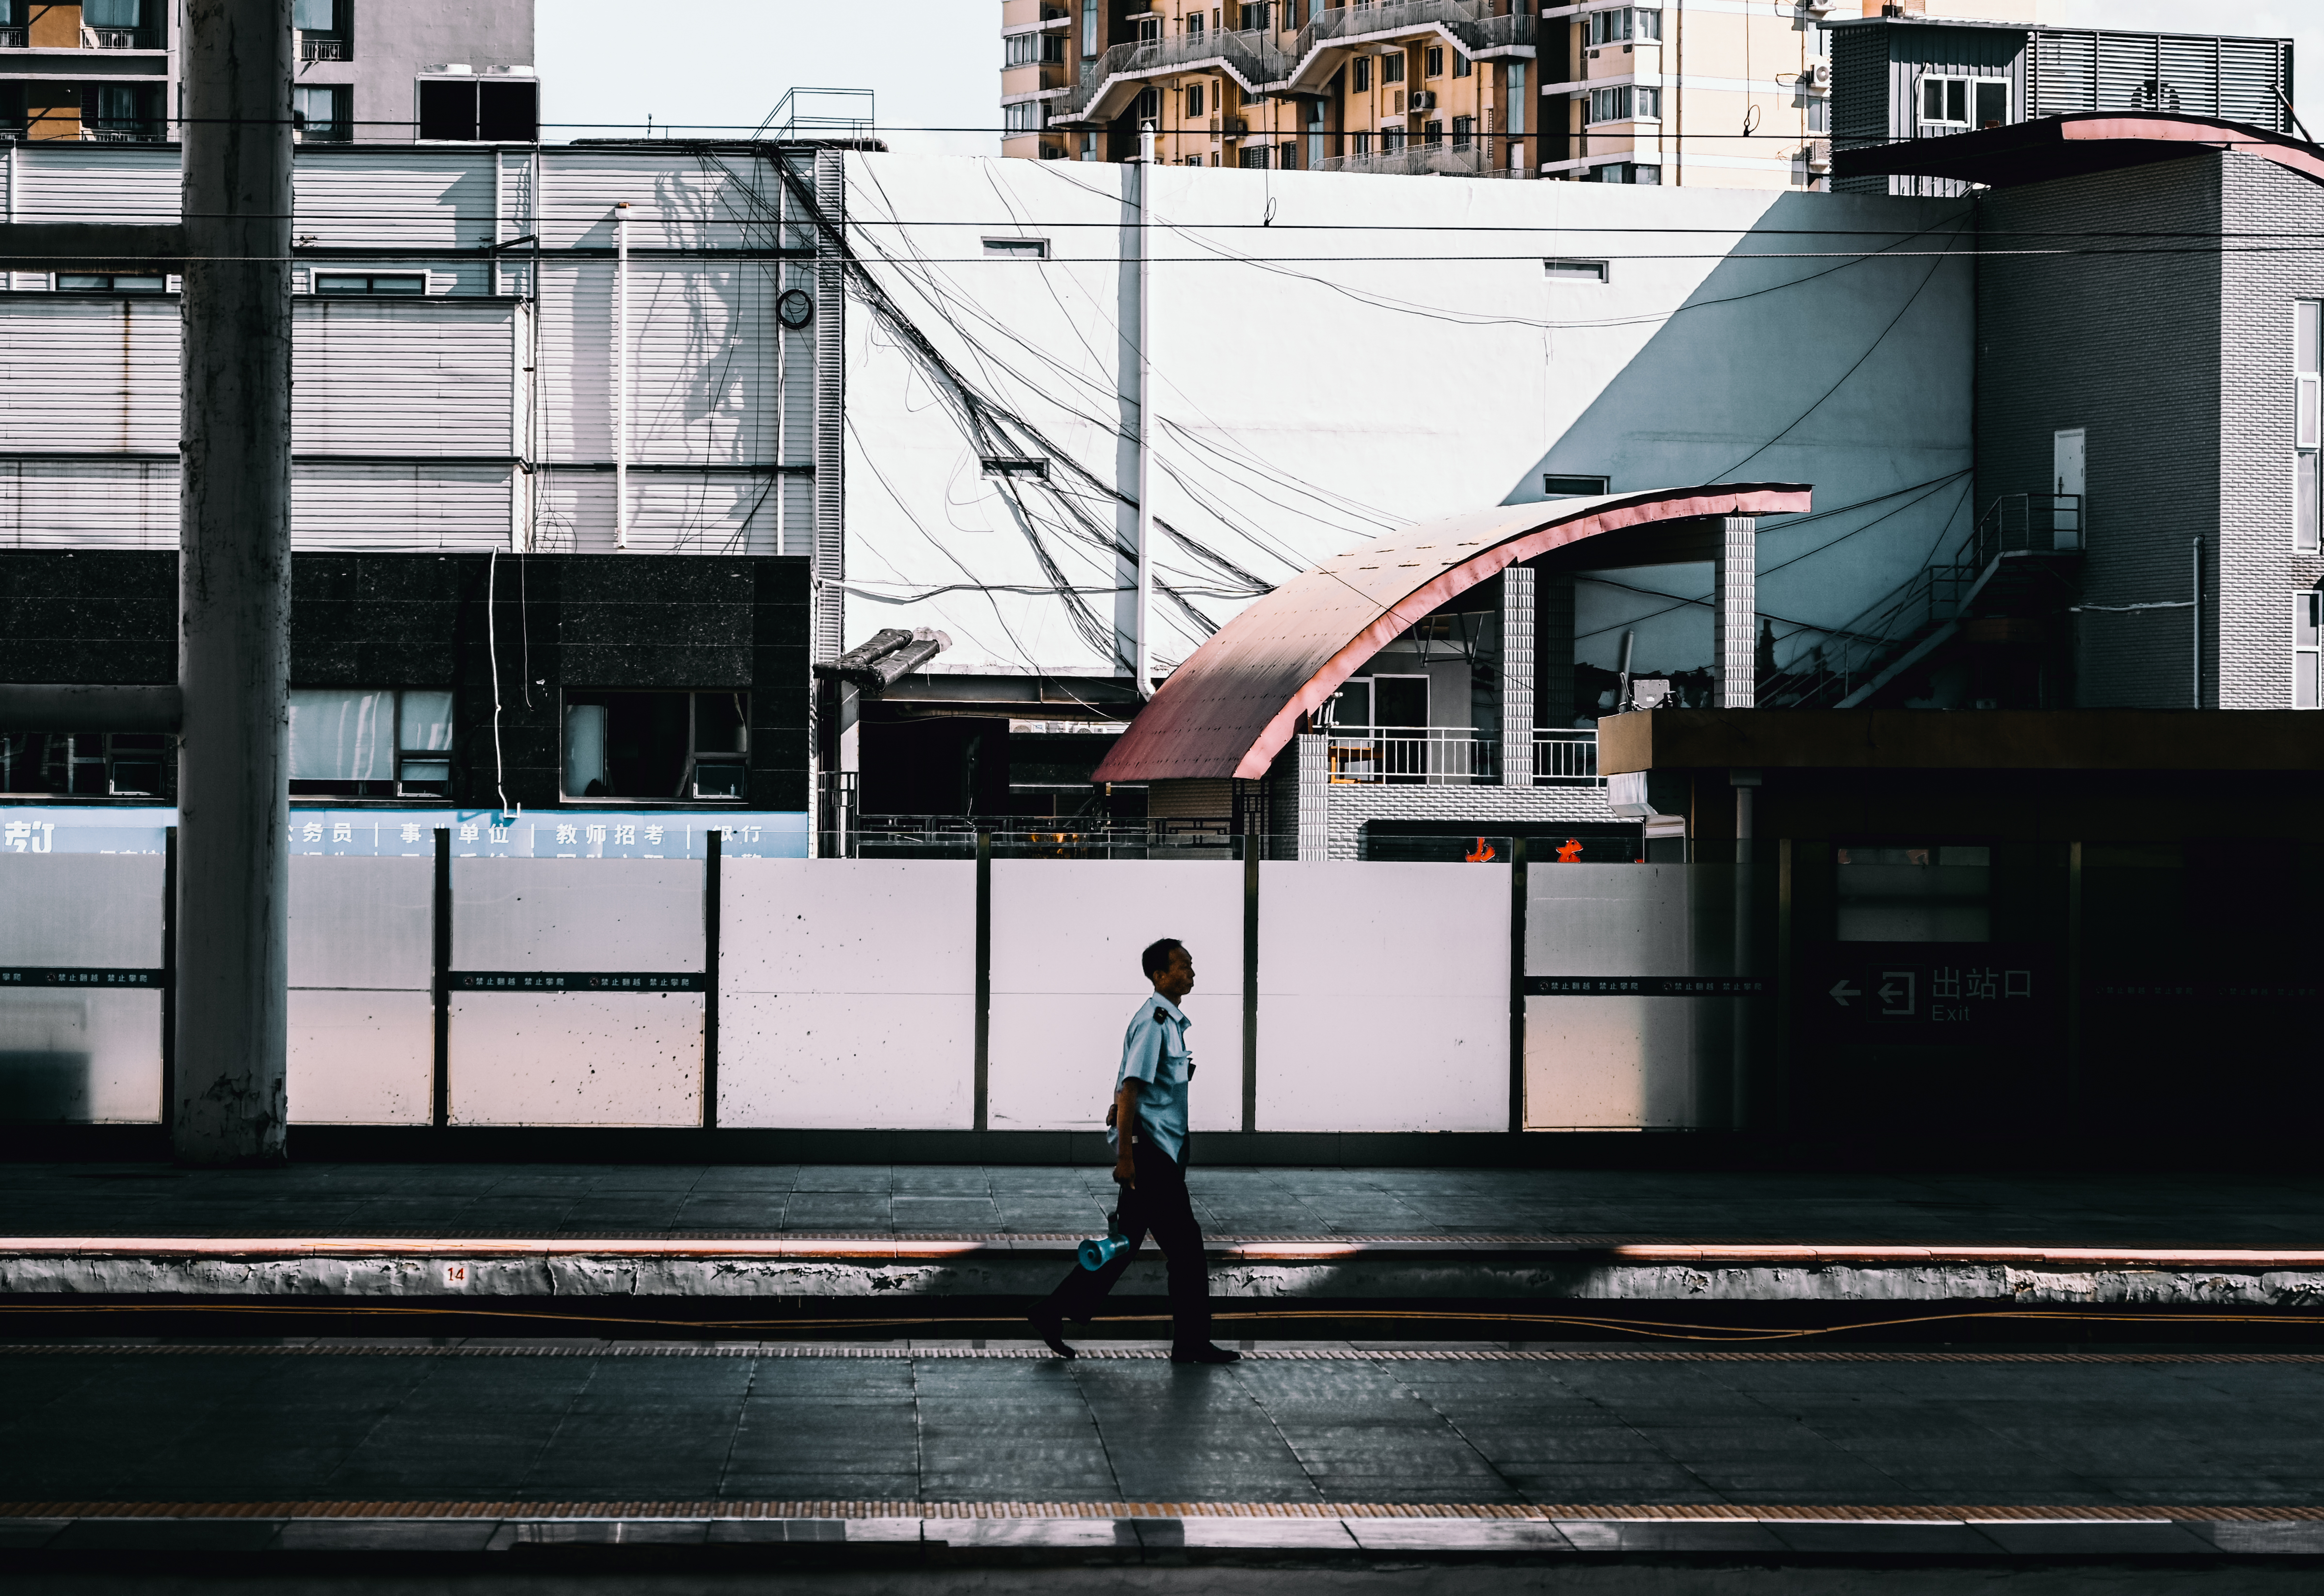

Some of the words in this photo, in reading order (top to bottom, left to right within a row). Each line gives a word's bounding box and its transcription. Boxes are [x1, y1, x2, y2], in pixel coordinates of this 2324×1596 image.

[288, 822, 352, 843] 务员
[556, 823, 665, 846] 教师招考
[58, 974, 98, 982] 禁止翻越
[108, 974, 147, 983] 禁止攀爬
[476, 977, 515, 986] 禁止翻越
[525, 977, 564, 986] 禁止攀爬
[601, 978, 641, 986] 禁止翻越
[650, 978, 689, 987] 禁止攀爬
[1933, 966, 2031, 1000] 出站口
[1675, 982, 1714, 990] 禁止翻越
[1723, 982, 1762, 990] 禁止攀爬
[1932, 1005, 1971, 1021] Exit
[448, 1267, 465, 1281] 14
